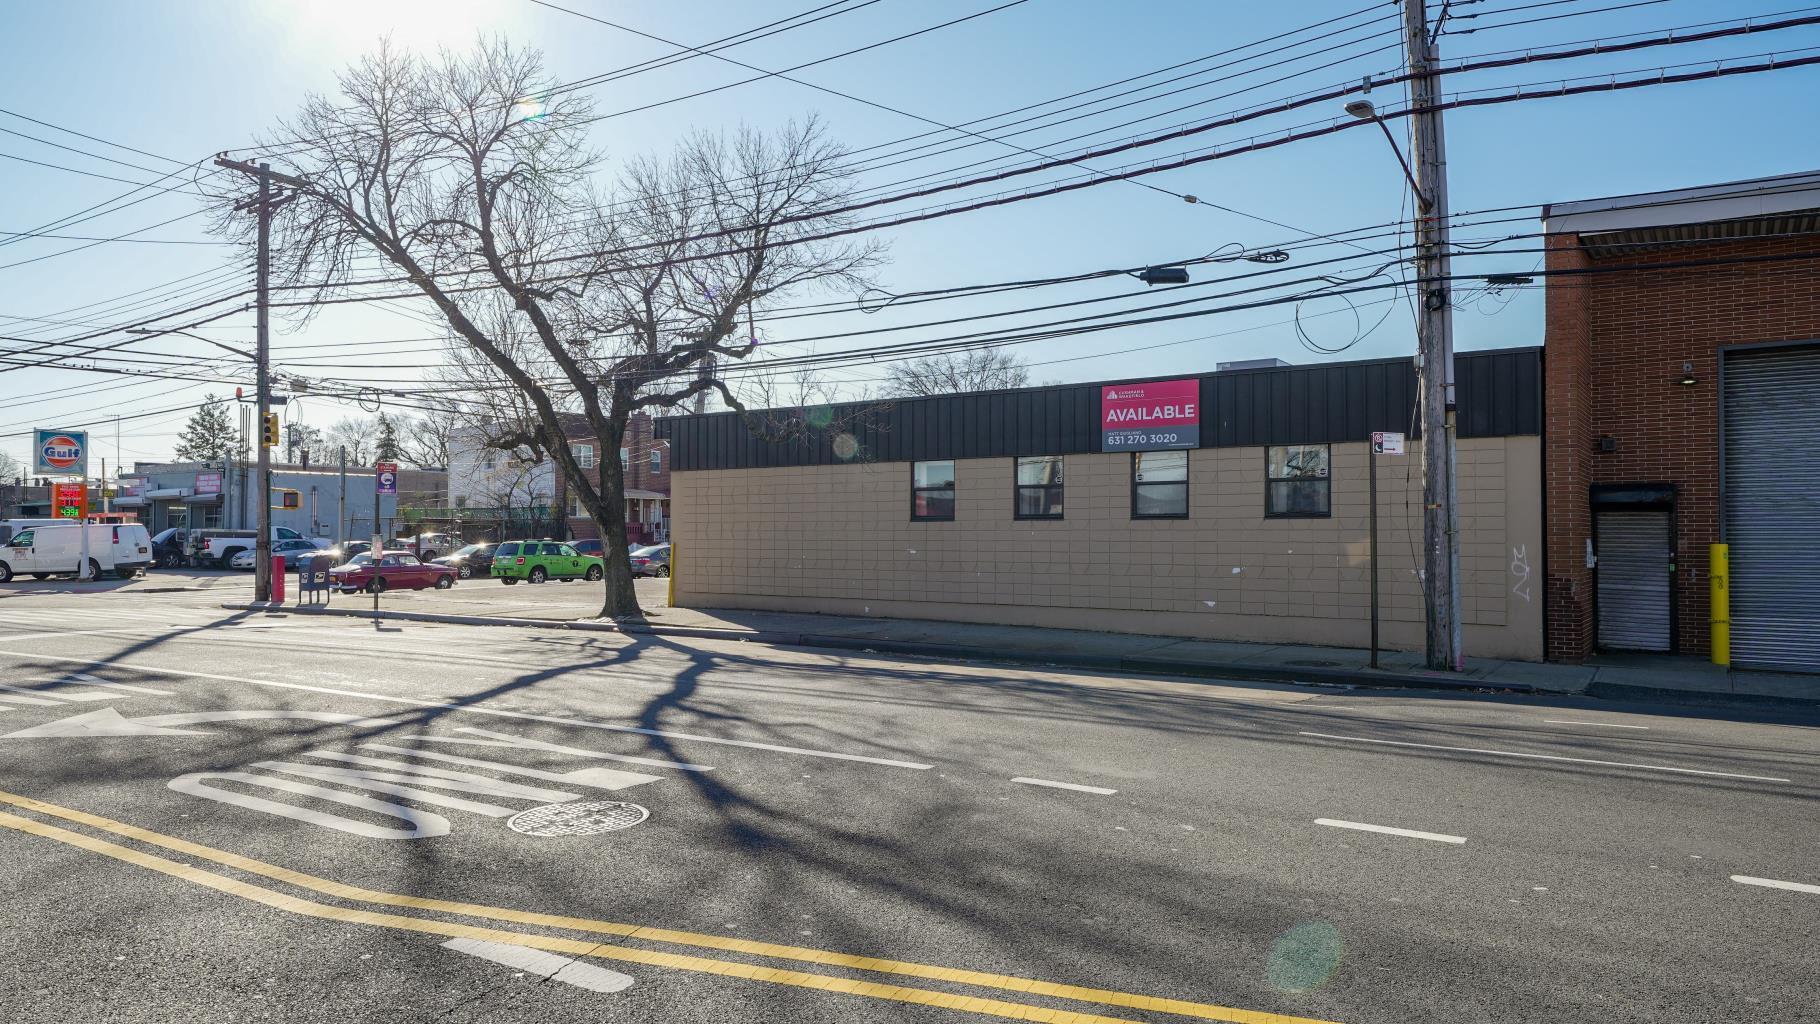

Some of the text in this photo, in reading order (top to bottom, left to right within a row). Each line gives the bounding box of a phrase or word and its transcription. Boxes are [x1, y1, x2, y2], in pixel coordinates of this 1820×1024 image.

[1107, 404, 1195, 422] AVAILABLE
[1108, 433, 1177, 445] 631 270 3020
[44, 446, 80, 458] Gulf
[167, 727, 715, 840] ONLY
